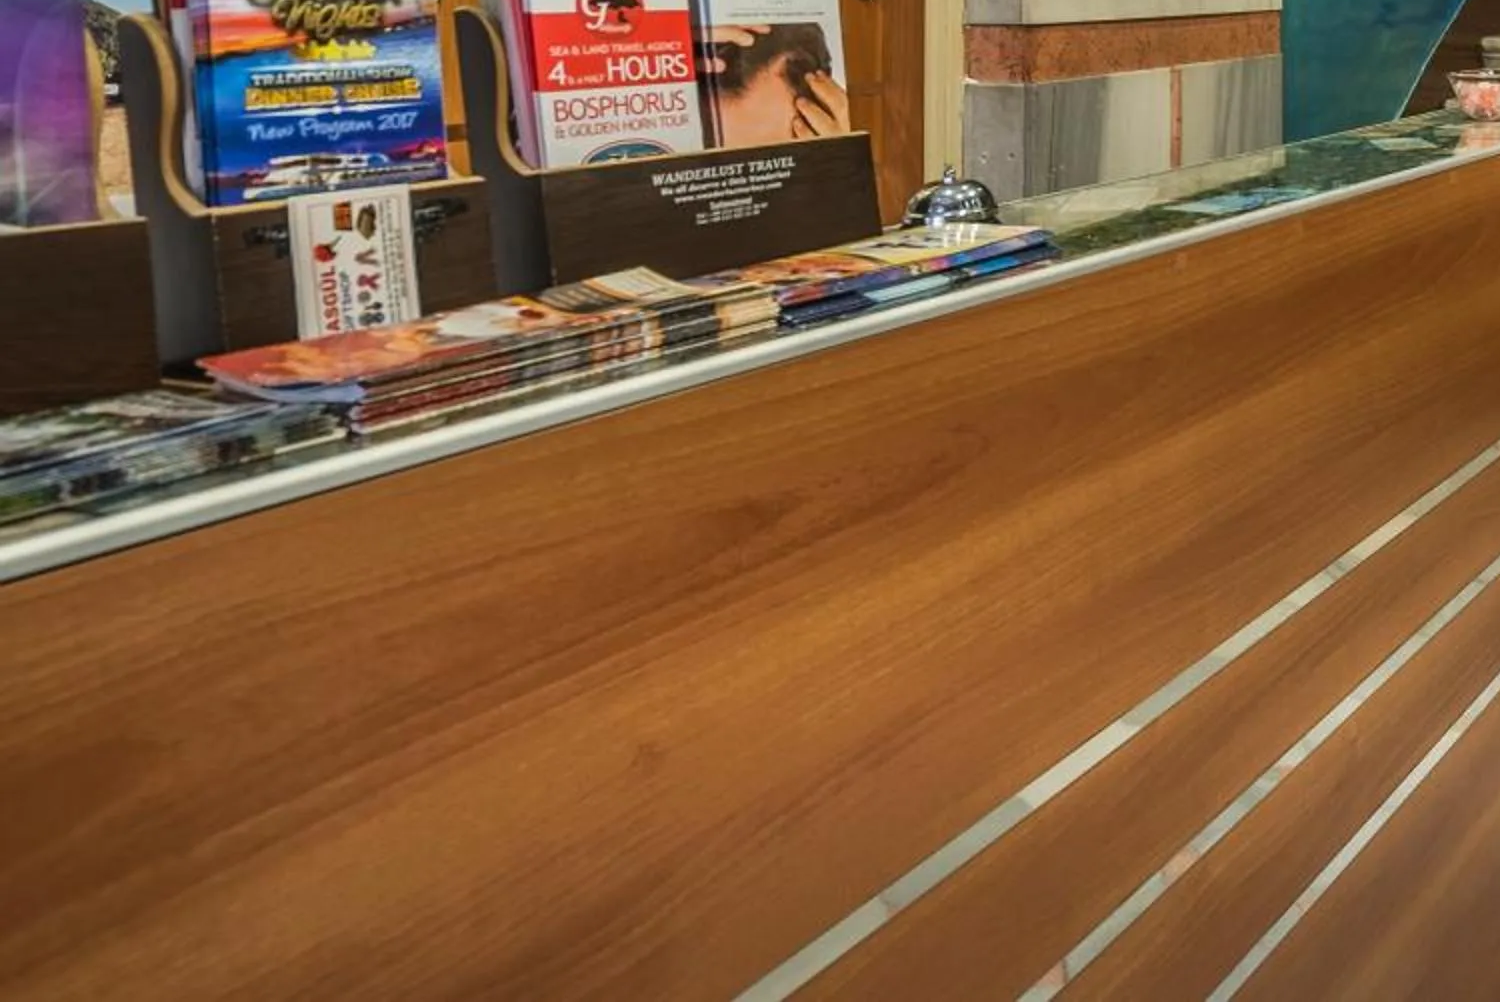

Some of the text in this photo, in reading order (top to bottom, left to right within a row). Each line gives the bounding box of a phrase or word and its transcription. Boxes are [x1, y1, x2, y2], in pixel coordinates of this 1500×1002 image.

[547, 58, 566, 87] 4
[606, 52, 689, 83] HOURS
[553, 89, 687, 123] BOSPHORUS
[298, 117, 374, 141] Program
[567, 120, 620, 138] GOLDEN
[622, 116, 658, 133] HORN
[651, 162, 745, 187] WANDERLUST
[748, 155, 796, 173] TRAVEL
